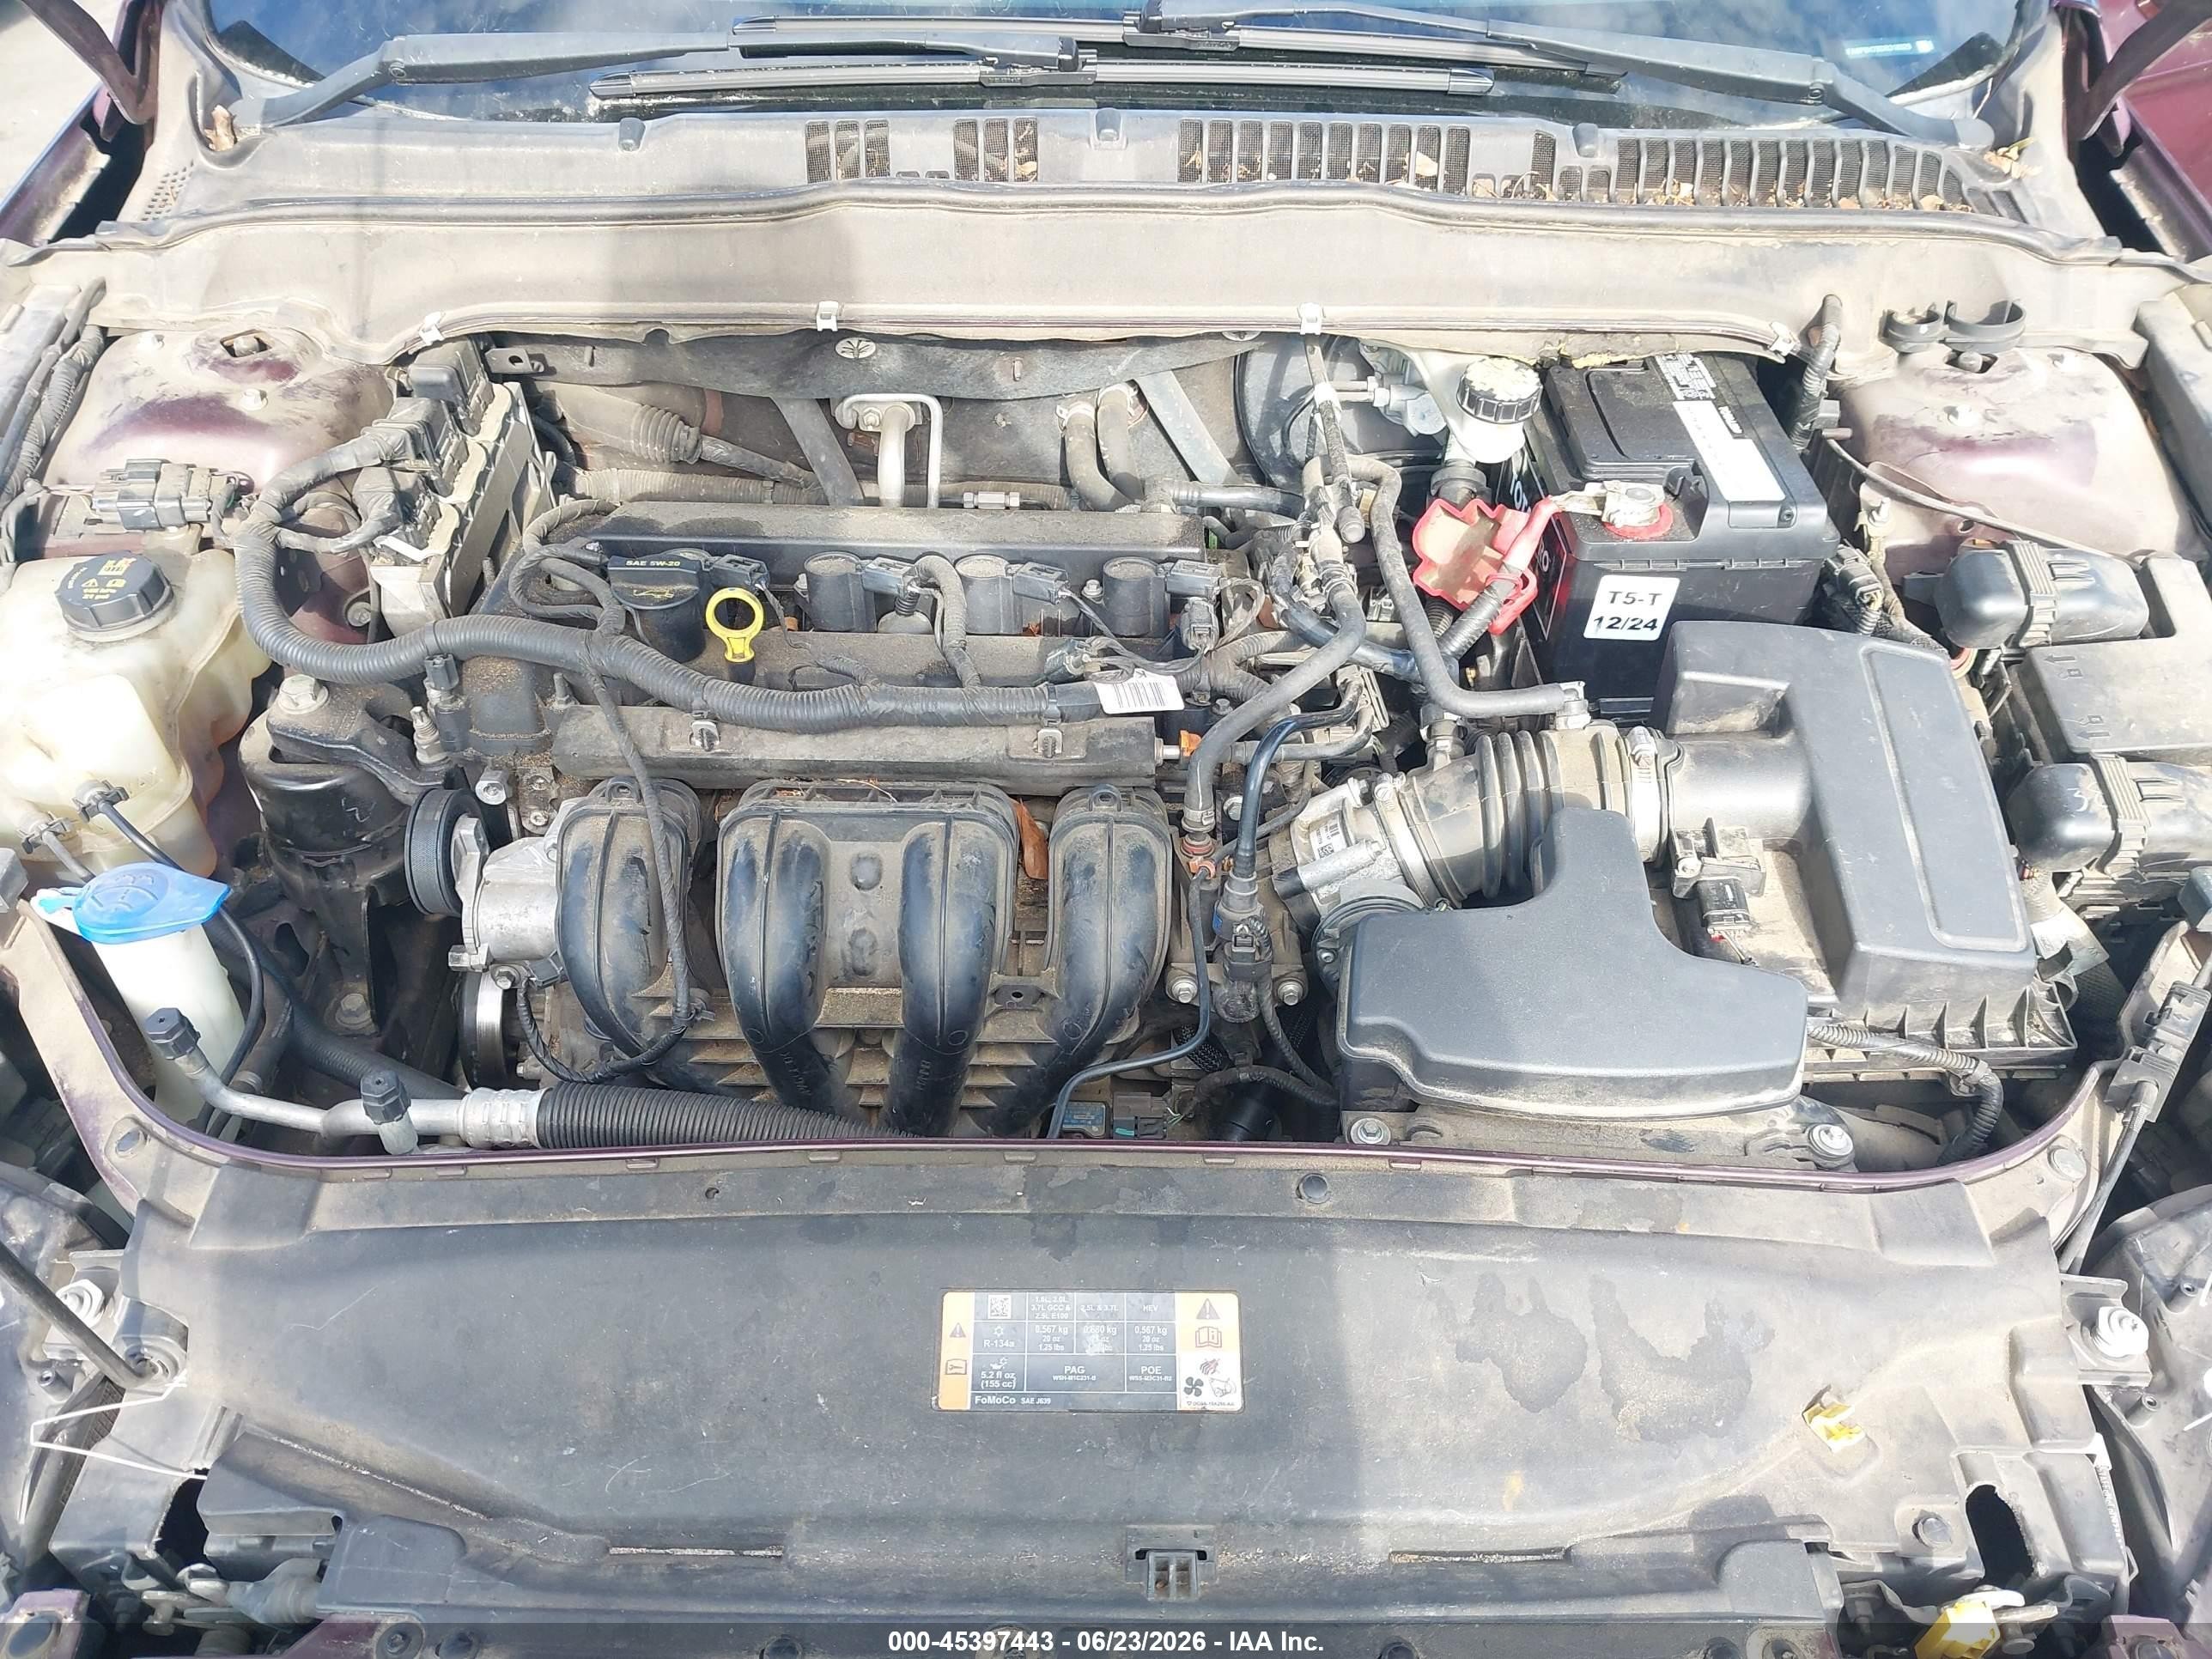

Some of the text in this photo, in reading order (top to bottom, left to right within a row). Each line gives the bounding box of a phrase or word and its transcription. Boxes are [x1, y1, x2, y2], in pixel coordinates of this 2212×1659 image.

[1608, 591, 1663, 606] T5-T
[1594, 616, 1658, 632] 12/24
[1058, 1325, 1068, 1336] kg
[1106, 1325, 1117, 1336] kg
[1157, 1325, 1168, 1336] kg
[995, 1370, 1003, 1379] fl
[1064, 1365, 1086, 1375] PAG
[1140, 1365, 1162, 1375] POE
[981, 1377, 1017, 1389] (155 cc)
[975, 1395, 1017, 1405] FoMoCo
